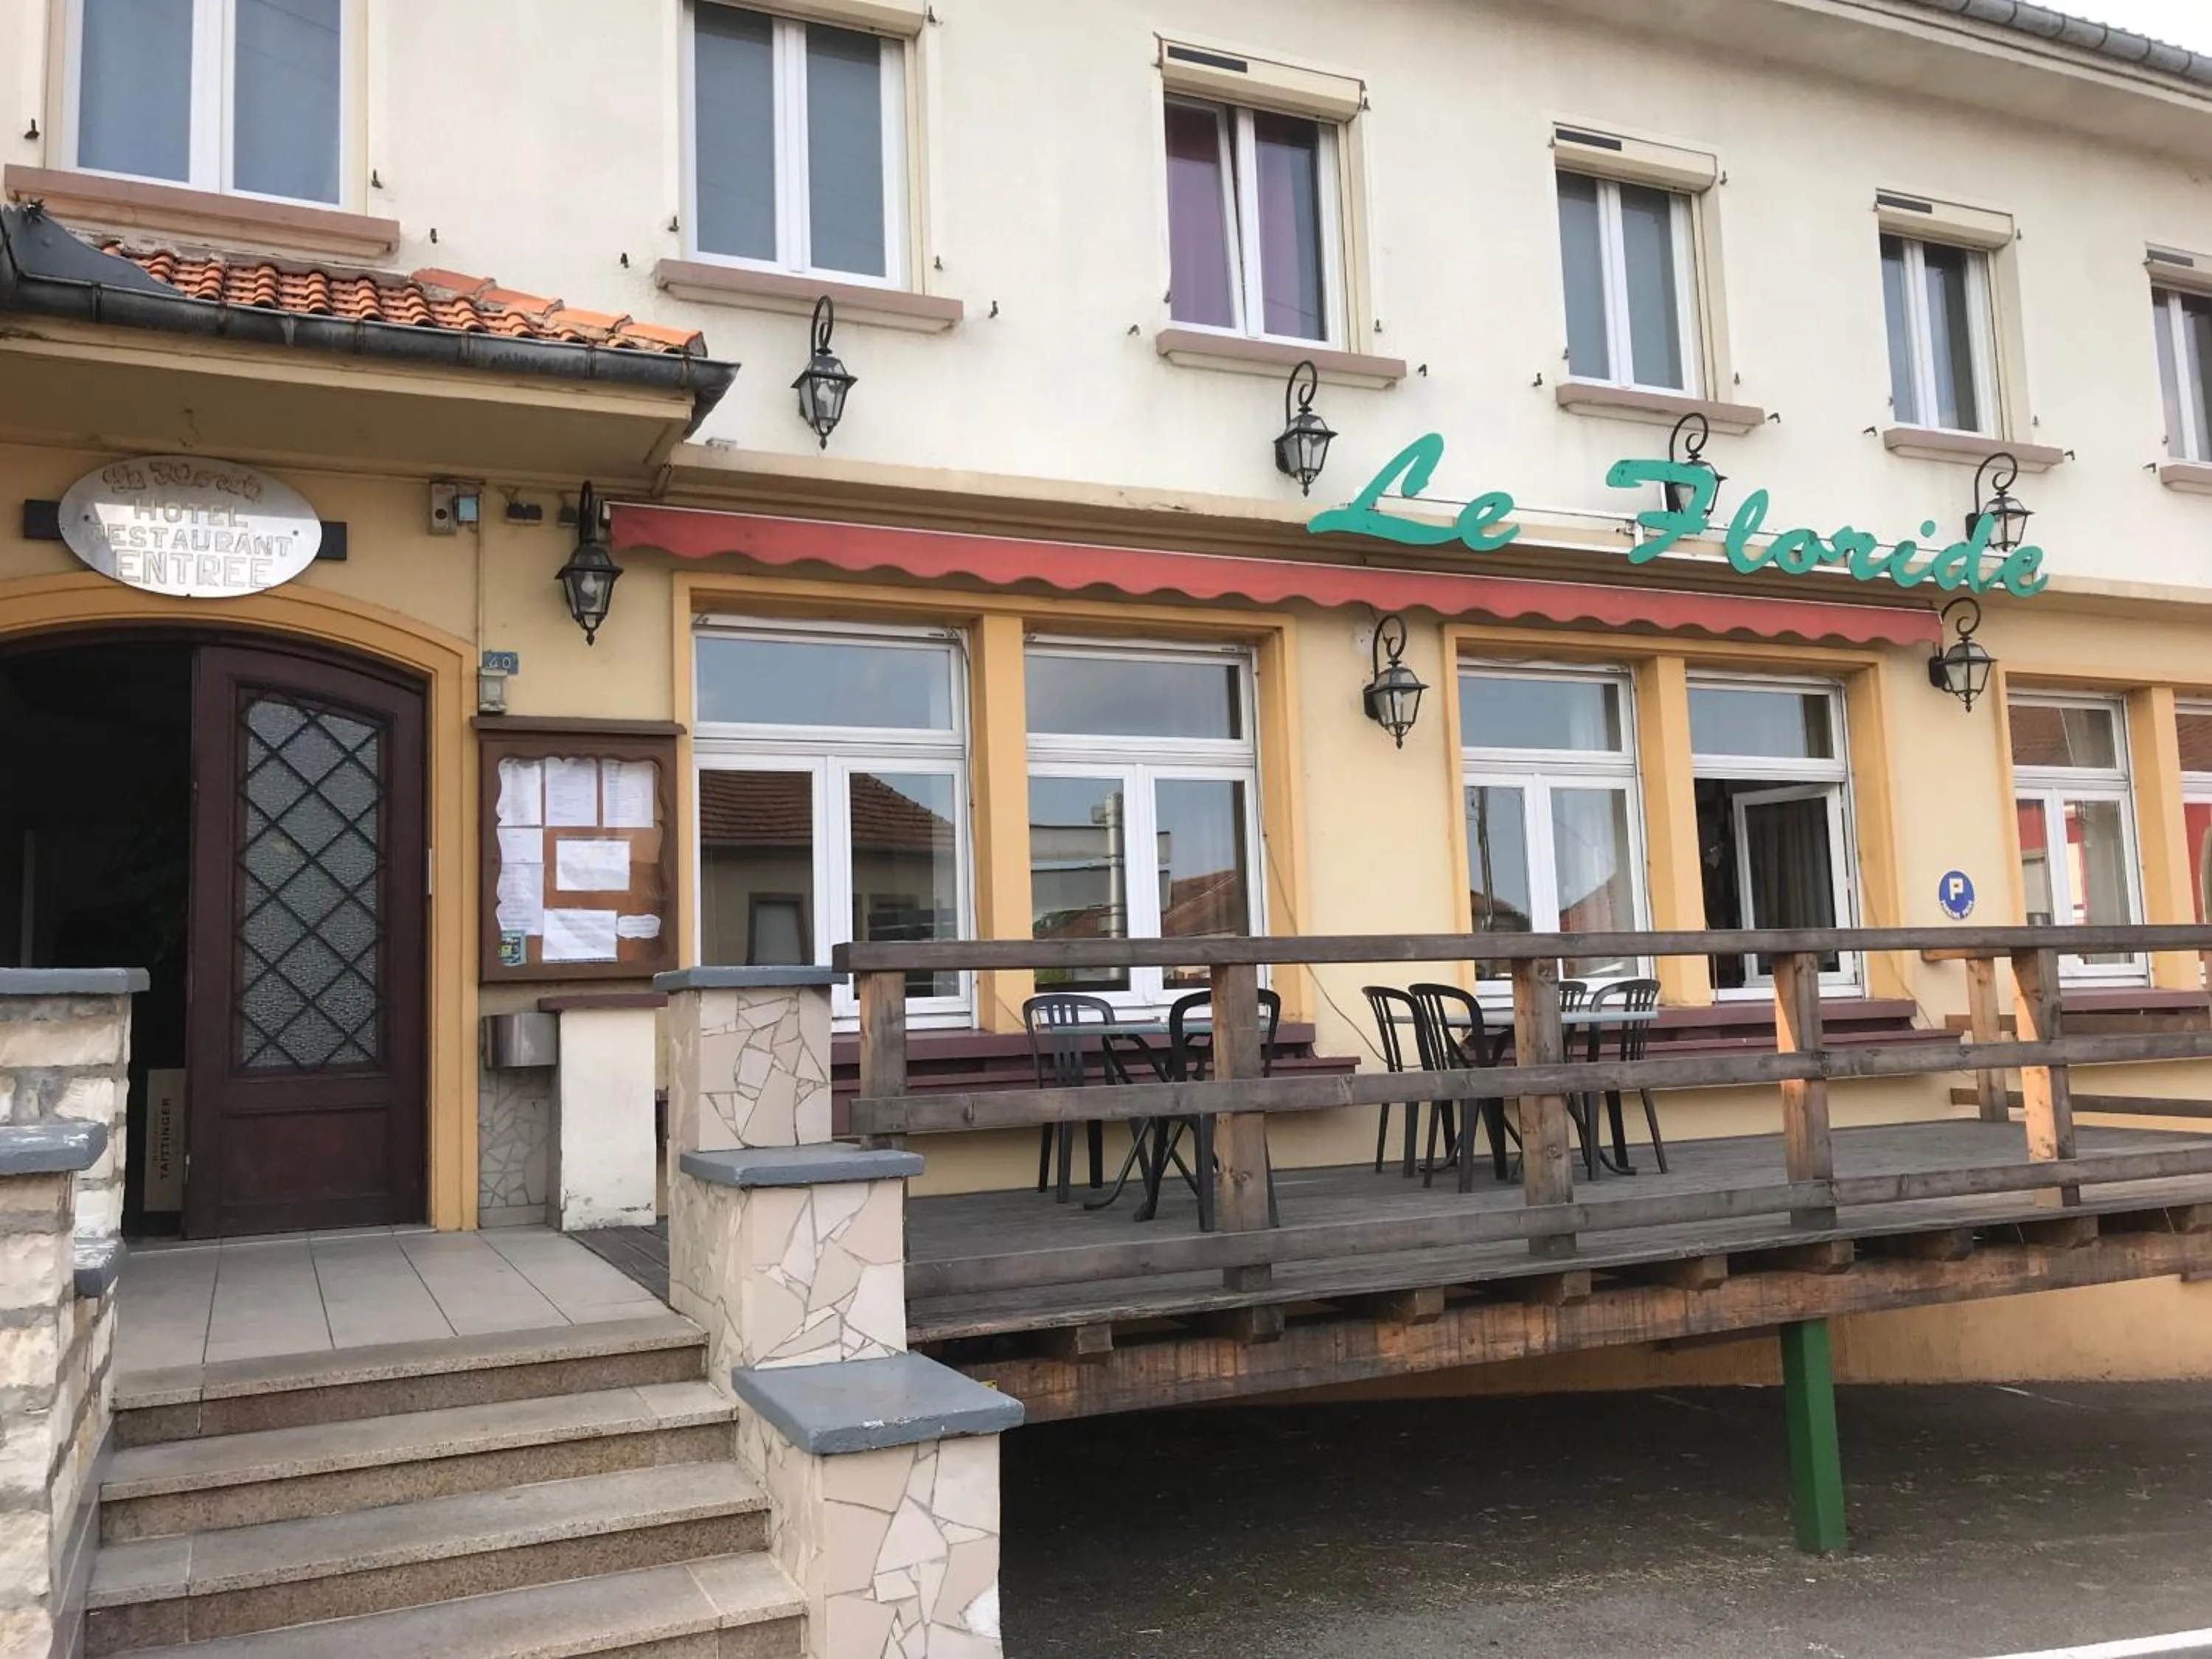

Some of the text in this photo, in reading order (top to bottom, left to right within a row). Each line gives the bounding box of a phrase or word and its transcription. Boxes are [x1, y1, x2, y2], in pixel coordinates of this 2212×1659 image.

[133, 497, 248, 528] HOTEL
[1307, 433, 2048, 597] Le Floride
[116, 549, 274, 588] ENTREE
[489, 655, 511, 669] 40
[1949, 877, 1964, 900] P
[161, 1098, 173, 1180] TAITTINGER
